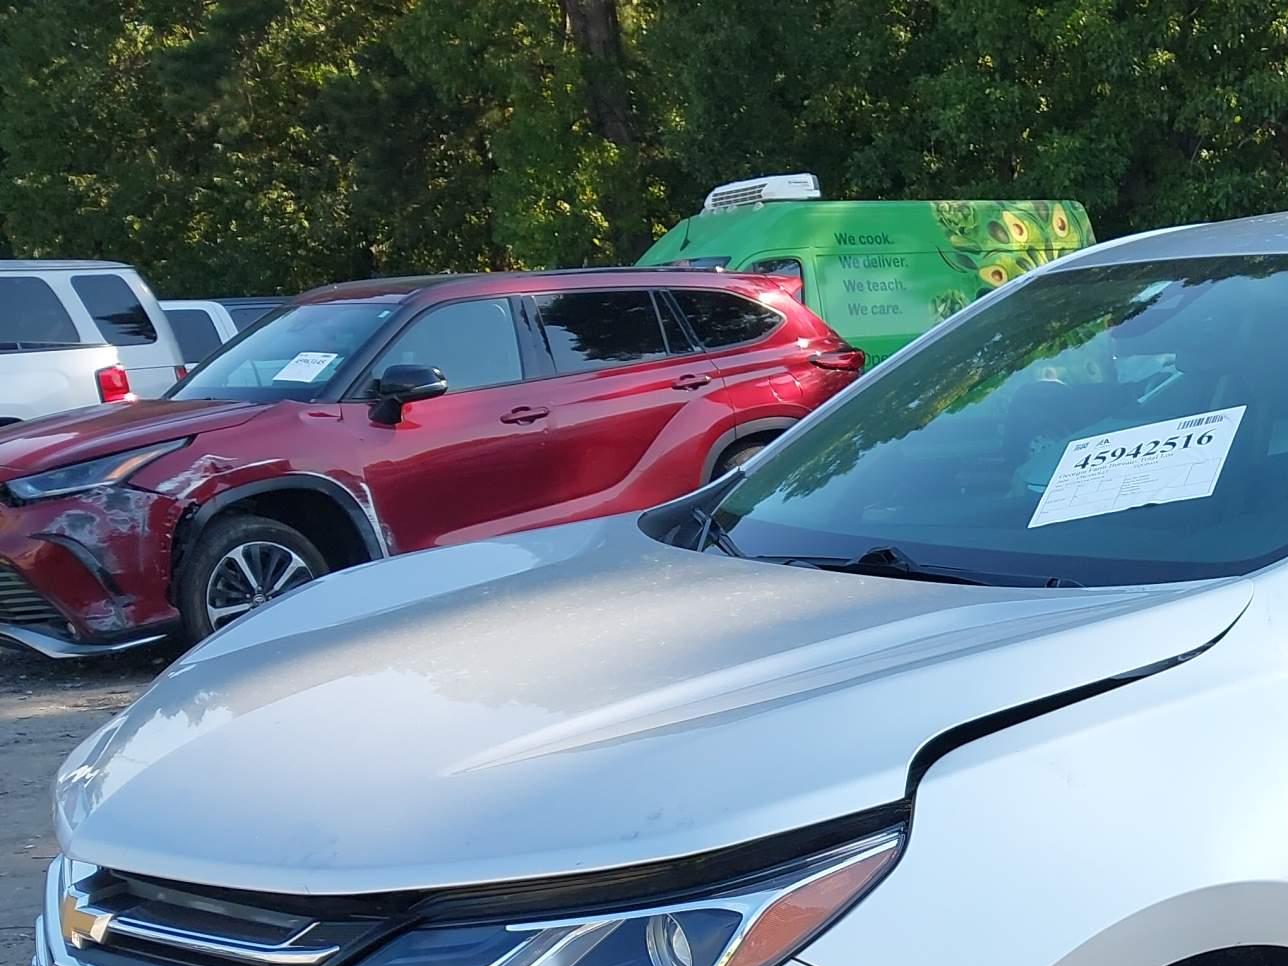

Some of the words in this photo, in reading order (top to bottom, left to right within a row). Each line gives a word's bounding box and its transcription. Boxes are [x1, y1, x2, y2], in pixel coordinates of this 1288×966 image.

[835, 232, 856, 245] We
[858, 232, 896, 245] cook.
[839, 255, 860, 269] We
[862, 254, 909, 269] deliver.
[843, 279, 864, 293] We
[866, 278, 907, 292] teach.
[847, 303, 868, 316] We
[871, 303, 904, 316] care.
[1074, 429, 1216, 469] 45942516
